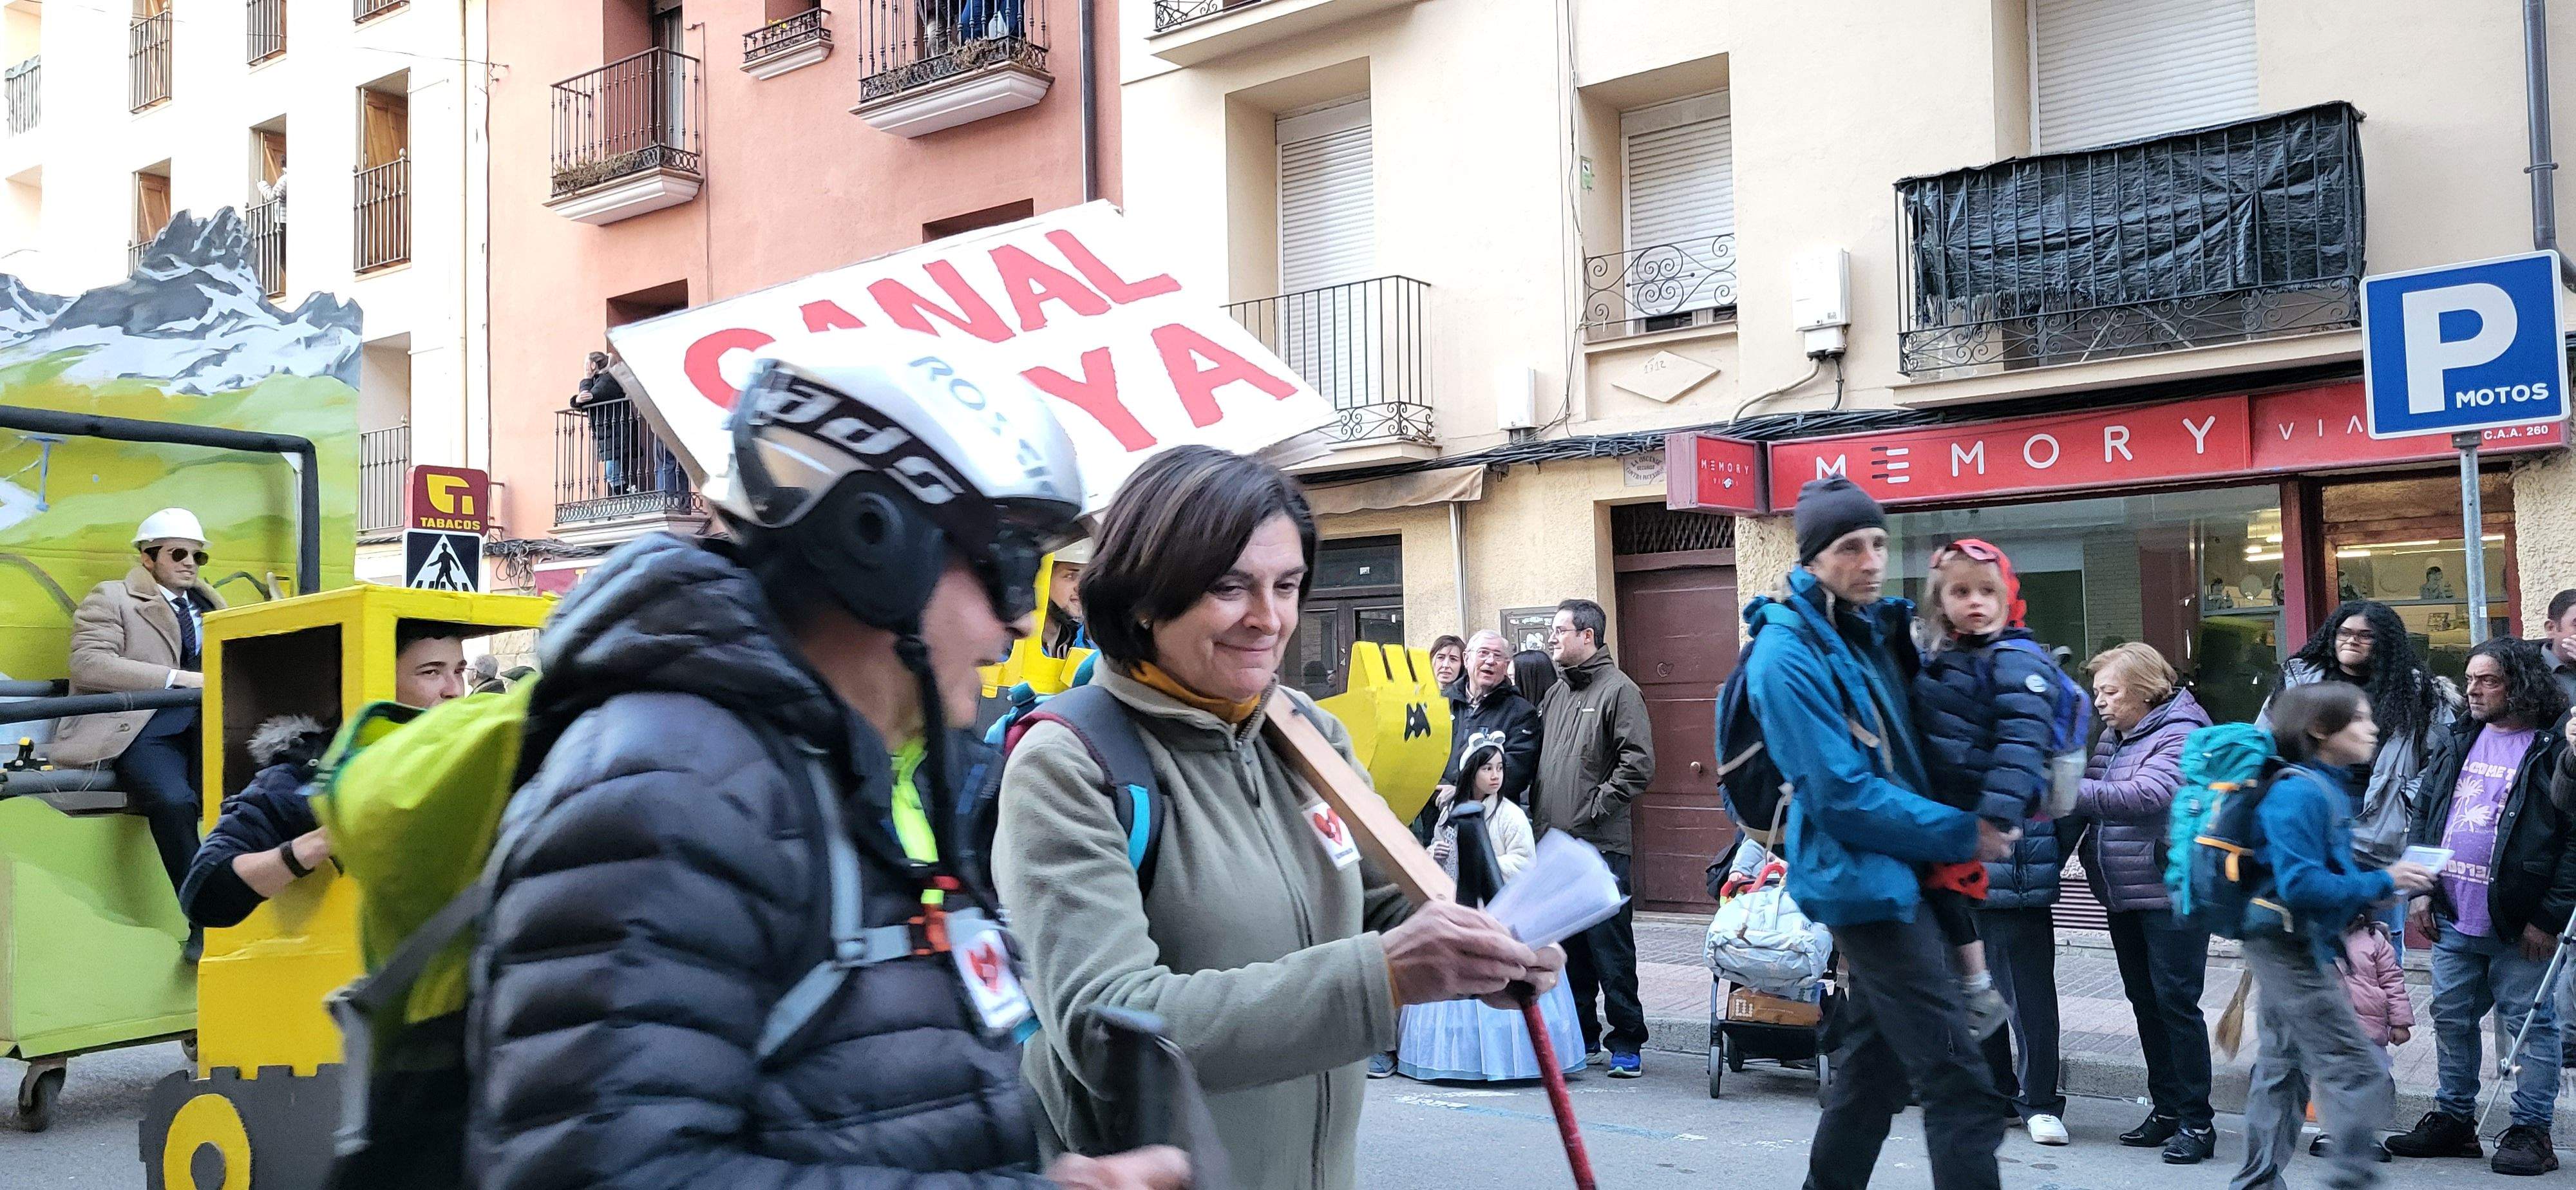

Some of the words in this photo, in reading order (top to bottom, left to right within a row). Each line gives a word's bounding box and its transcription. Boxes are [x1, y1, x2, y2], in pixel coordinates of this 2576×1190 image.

[2402, 283, 2518, 414] P
[2456, 382, 2550, 408] MOTOS
[2483, 428, 2522, 440] C.A.A.
[2526, 425, 2549, 436] 260
[1815, 415, 2215, 484] MEMORY
[1701, 458, 1749, 475] MEMORY
[420, 516, 481, 531] TABACOS
